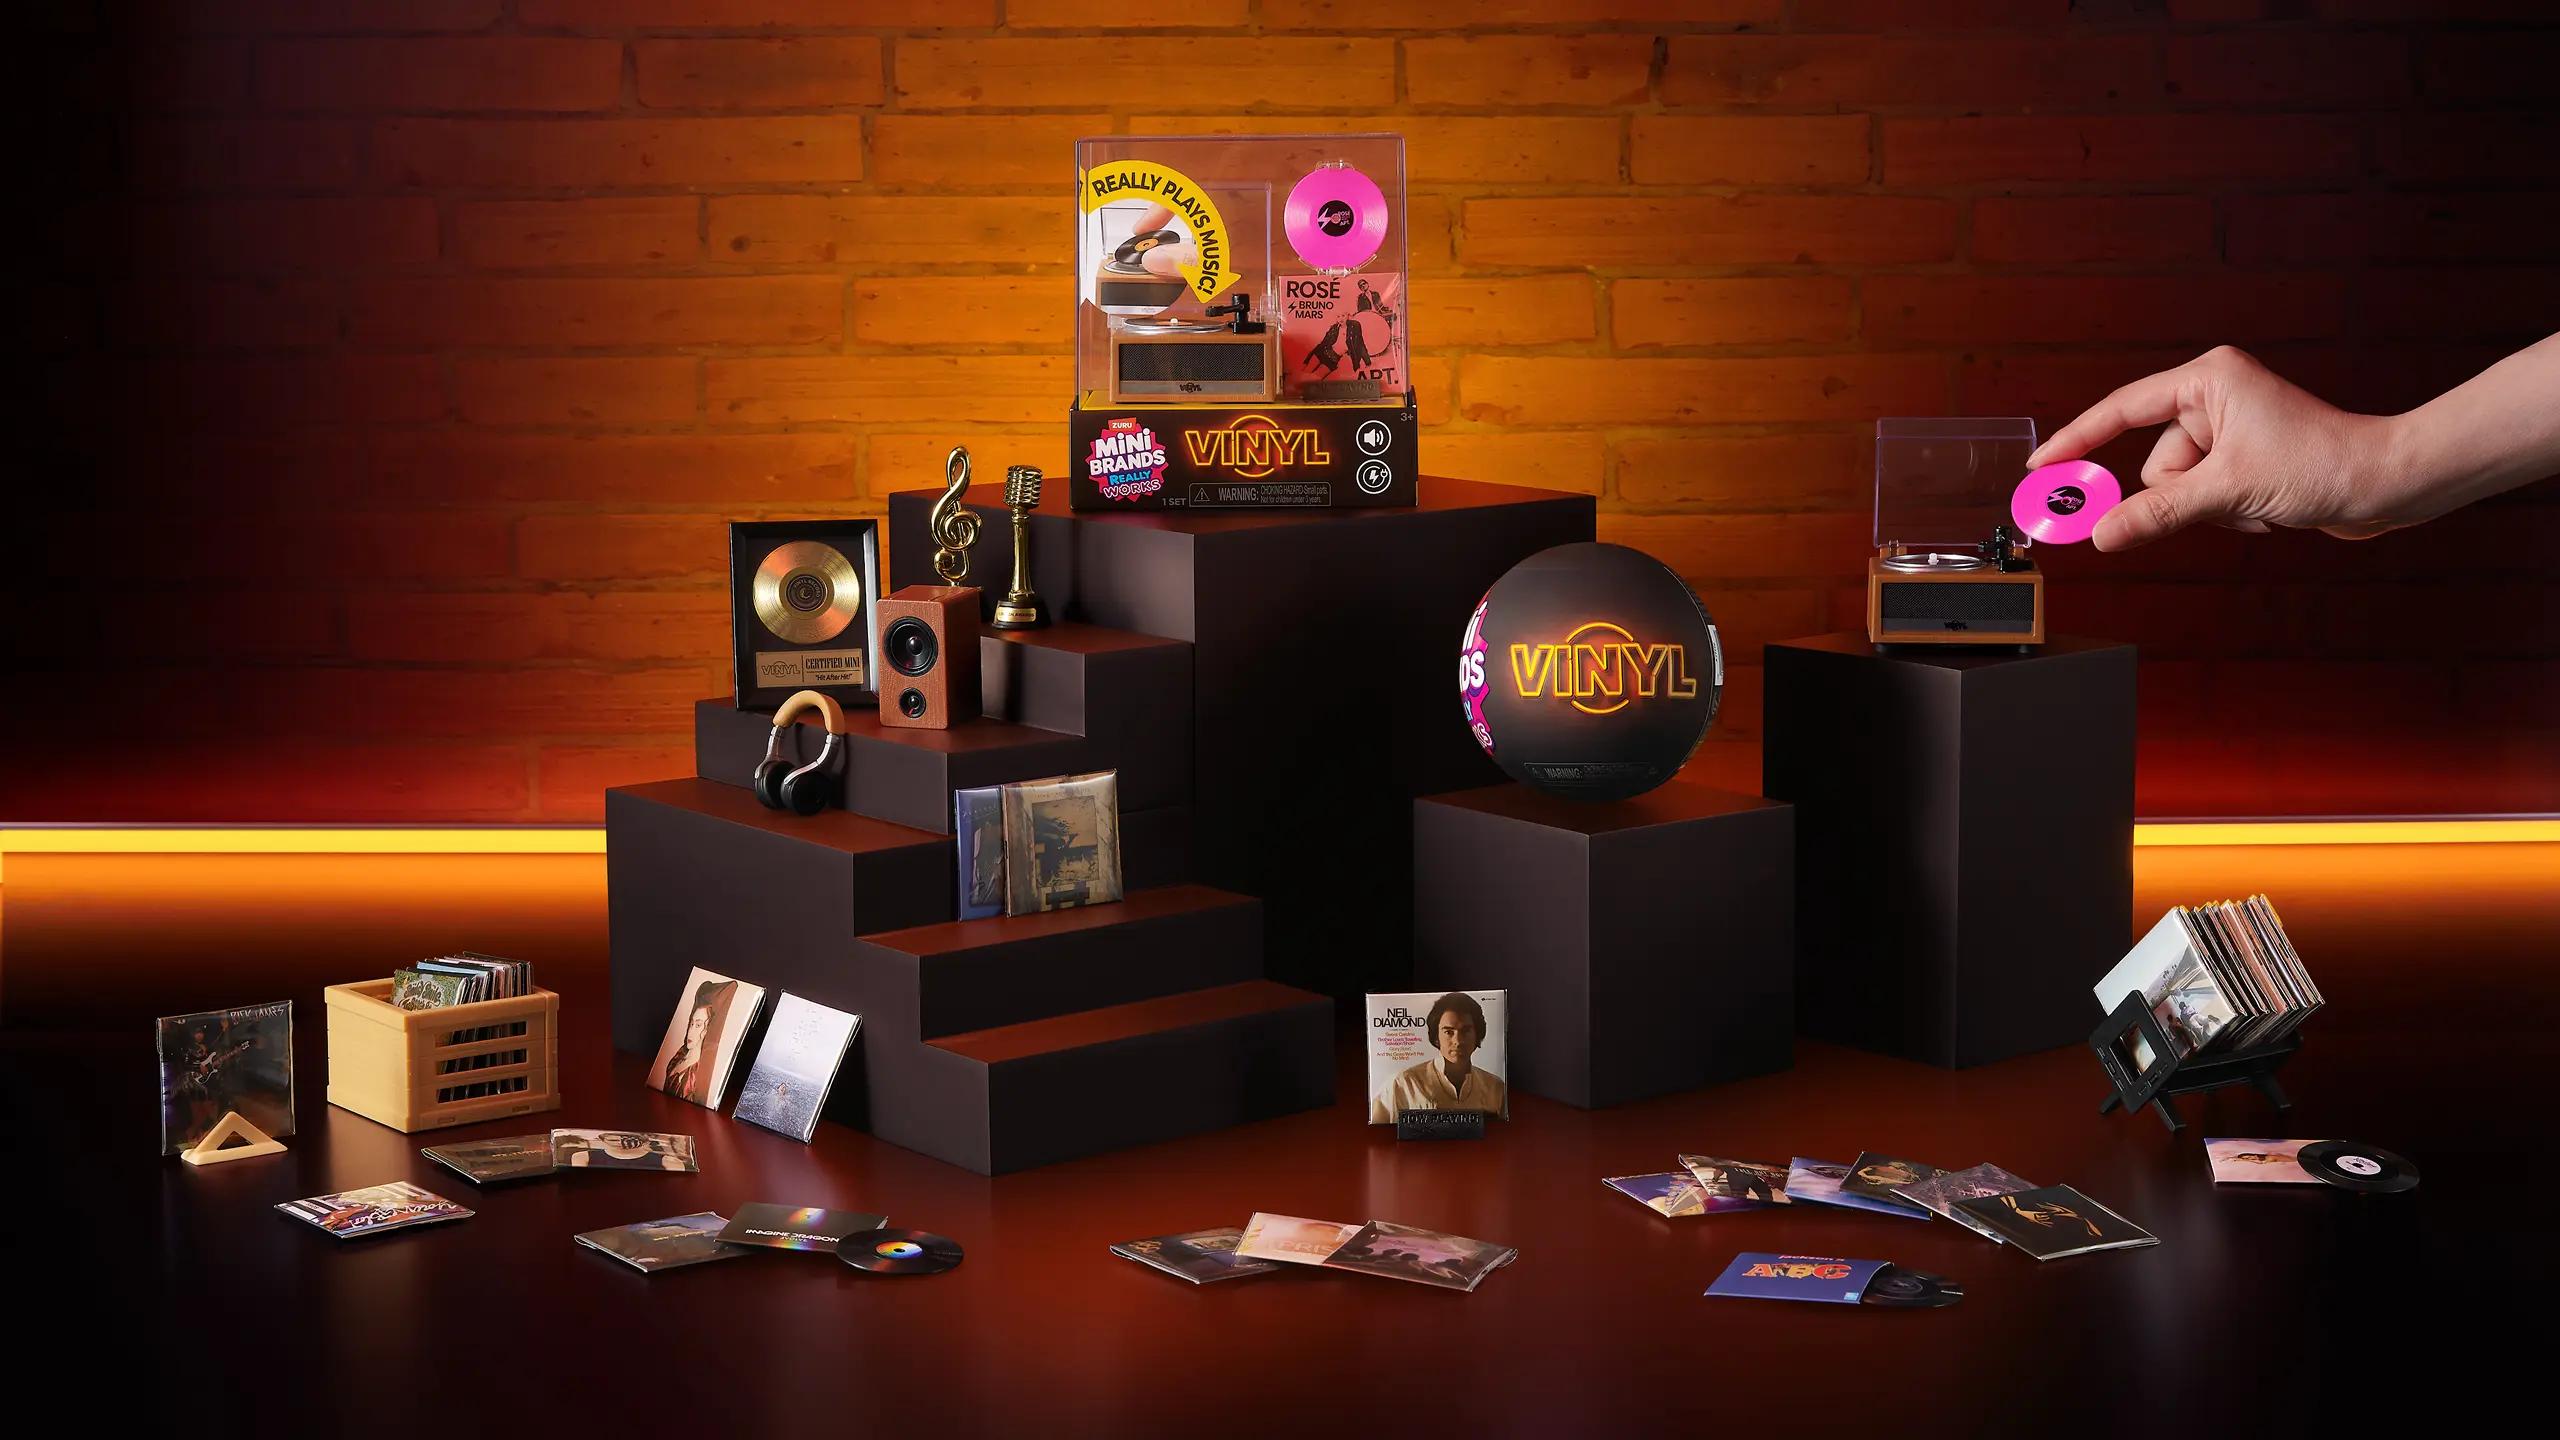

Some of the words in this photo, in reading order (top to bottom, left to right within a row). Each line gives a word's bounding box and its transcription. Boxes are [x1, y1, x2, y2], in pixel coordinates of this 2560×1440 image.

[1092, 172, 1162, 197] REALLY
[1162, 180, 1210, 228] PLAYS
[1196, 229, 1220, 296] MUSIC!
[1286, 277, 1340, 299] ROSÉ
[1299, 301, 1334, 310] BRUNO
[1295, 310, 1324, 319] MARS
[1400, 412, 1414, 422] 3+
[1184, 428, 1330, 466] VINYL
[1090, 450, 1166, 476] BRANDS
[1109, 470, 1151, 486] REALLY
[1103, 479, 1162, 498] WORKS
[1218, 488, 1259, 500] WARNING:
[762, 664, 800, 676] VINYL
[806, 658, 843, 670] CERTIFIED
[844, 656, 860, 668] MINI
[1510, 644, 1697, 698] VINYL
[1387, 1008, 1412, 1018] NEIL
[1374, 1018, 1426, 1028] DIAMOND
[746, 1228, 790, 1237] IMAGINE
[790, 1232, 840, 1243] DRAGON
[1742, 1263, 1852, 1280] ABC
